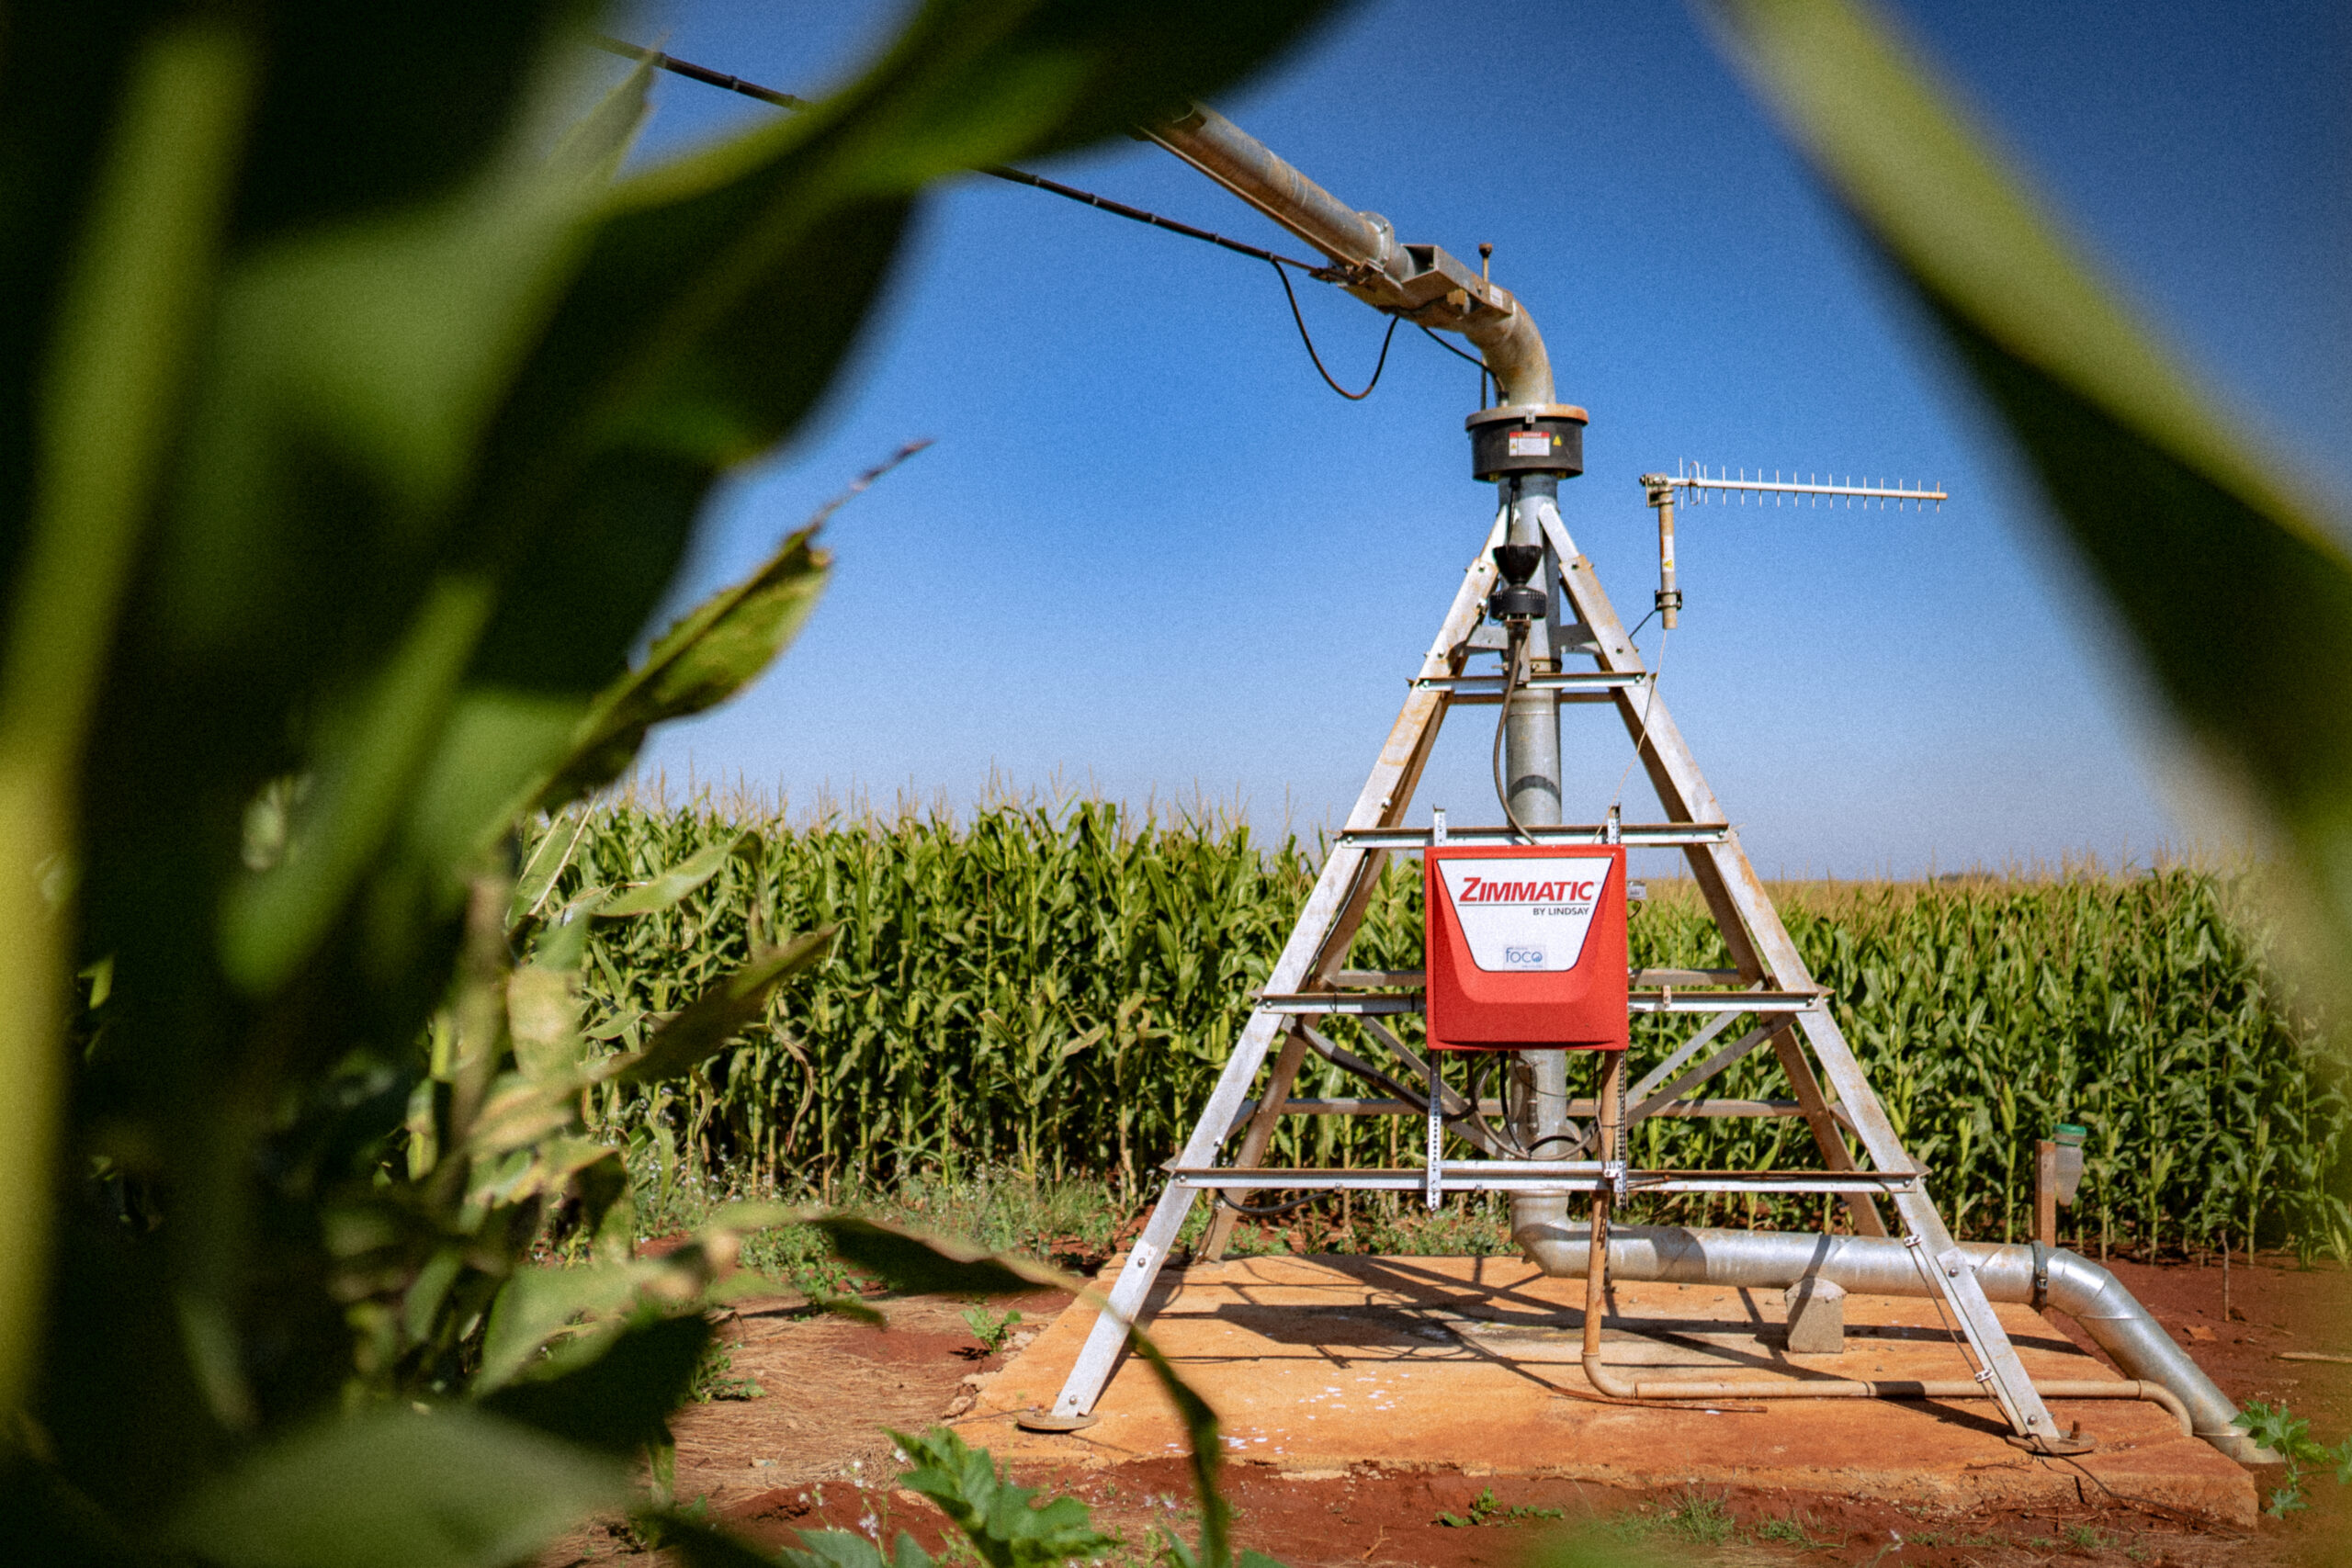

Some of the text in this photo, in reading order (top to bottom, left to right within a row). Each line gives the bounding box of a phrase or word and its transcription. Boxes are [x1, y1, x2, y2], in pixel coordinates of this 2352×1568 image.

[1459, 877, 1594, 902] ZIMMATIC
[1532, 908, 1590, 916] BY LINDSAY
